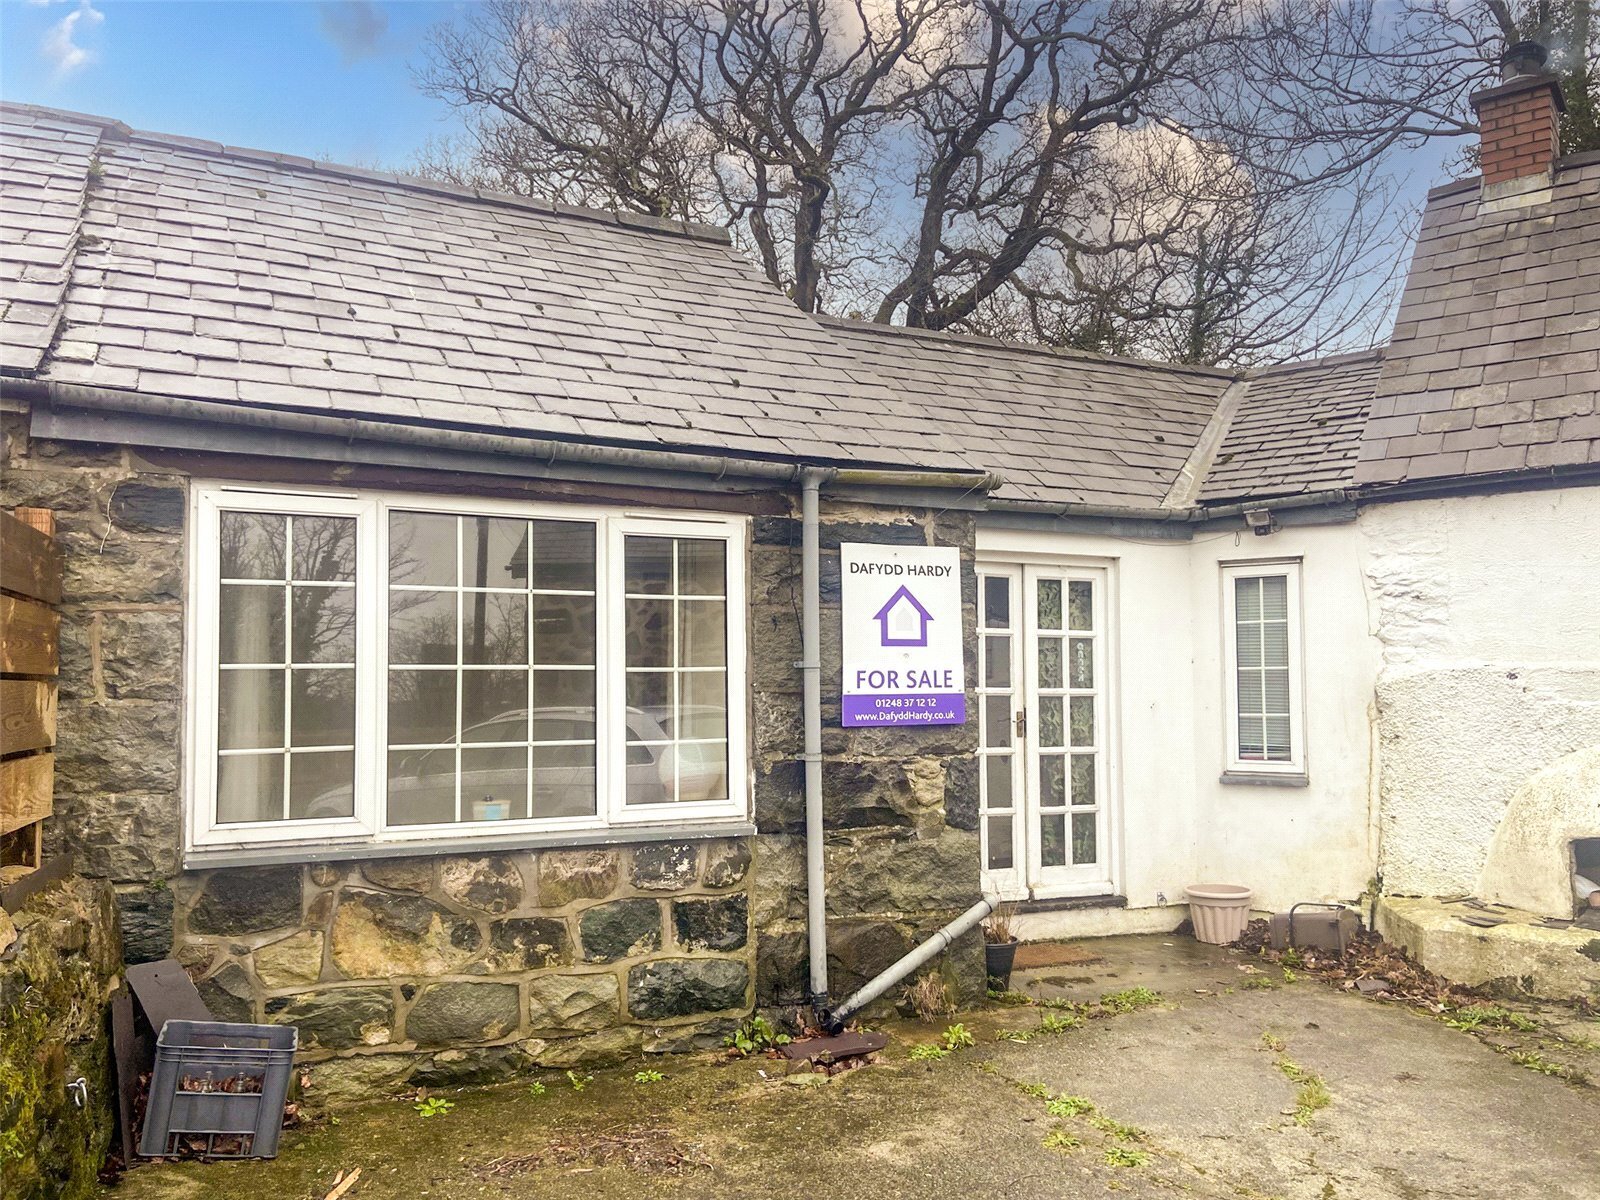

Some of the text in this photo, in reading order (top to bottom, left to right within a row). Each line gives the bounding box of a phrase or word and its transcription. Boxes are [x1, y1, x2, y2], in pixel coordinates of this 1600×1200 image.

[849, 562, 952, 577] DAFYDD HARDY
[856, 670, 953, 689] FOR SALE
[875, 698, 937, 708] 01248 37 12 12
[855, 711, 955, 722] www.DafyddHardy.co.uk
